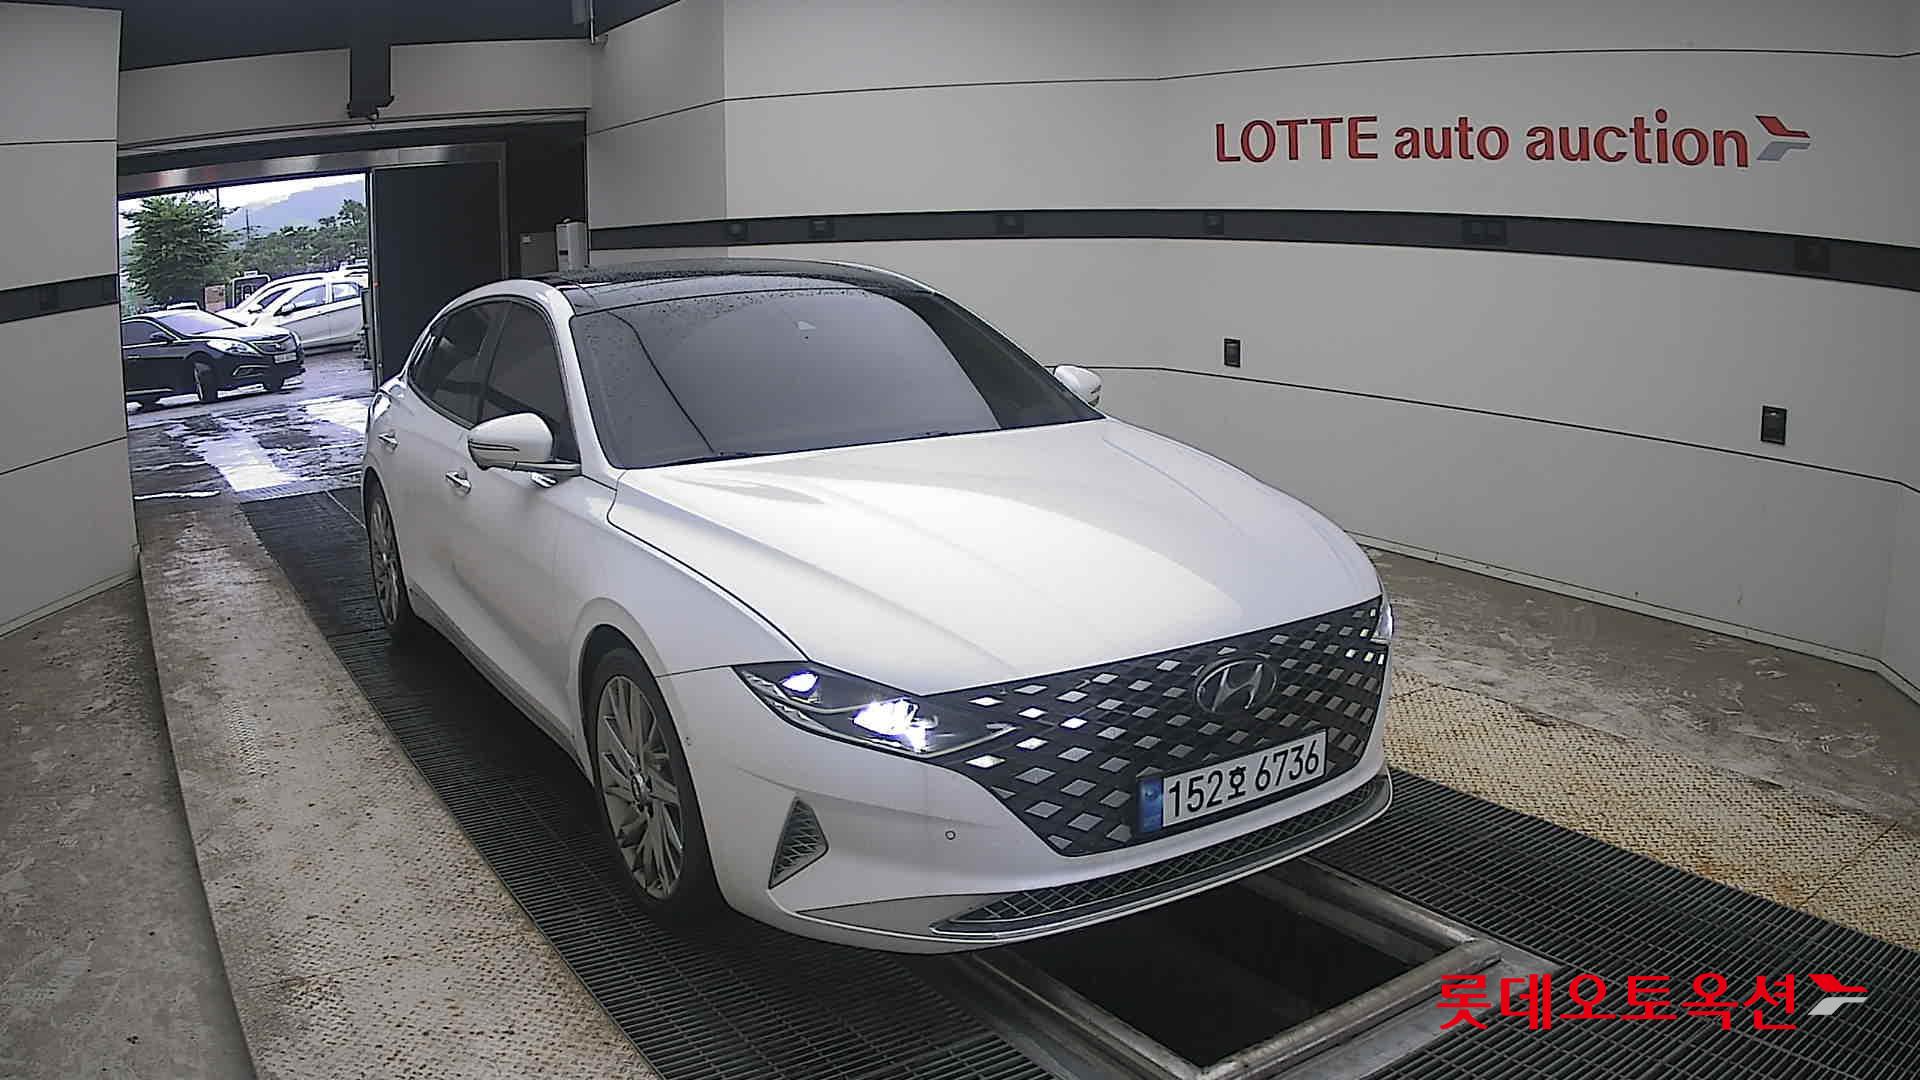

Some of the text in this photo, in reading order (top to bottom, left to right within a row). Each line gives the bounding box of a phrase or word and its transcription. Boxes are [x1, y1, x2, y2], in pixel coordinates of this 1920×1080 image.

[1216, 109, 1750, 168] LOTTE auto auction
[1168, 740, 1320, 818] 152호 6736
